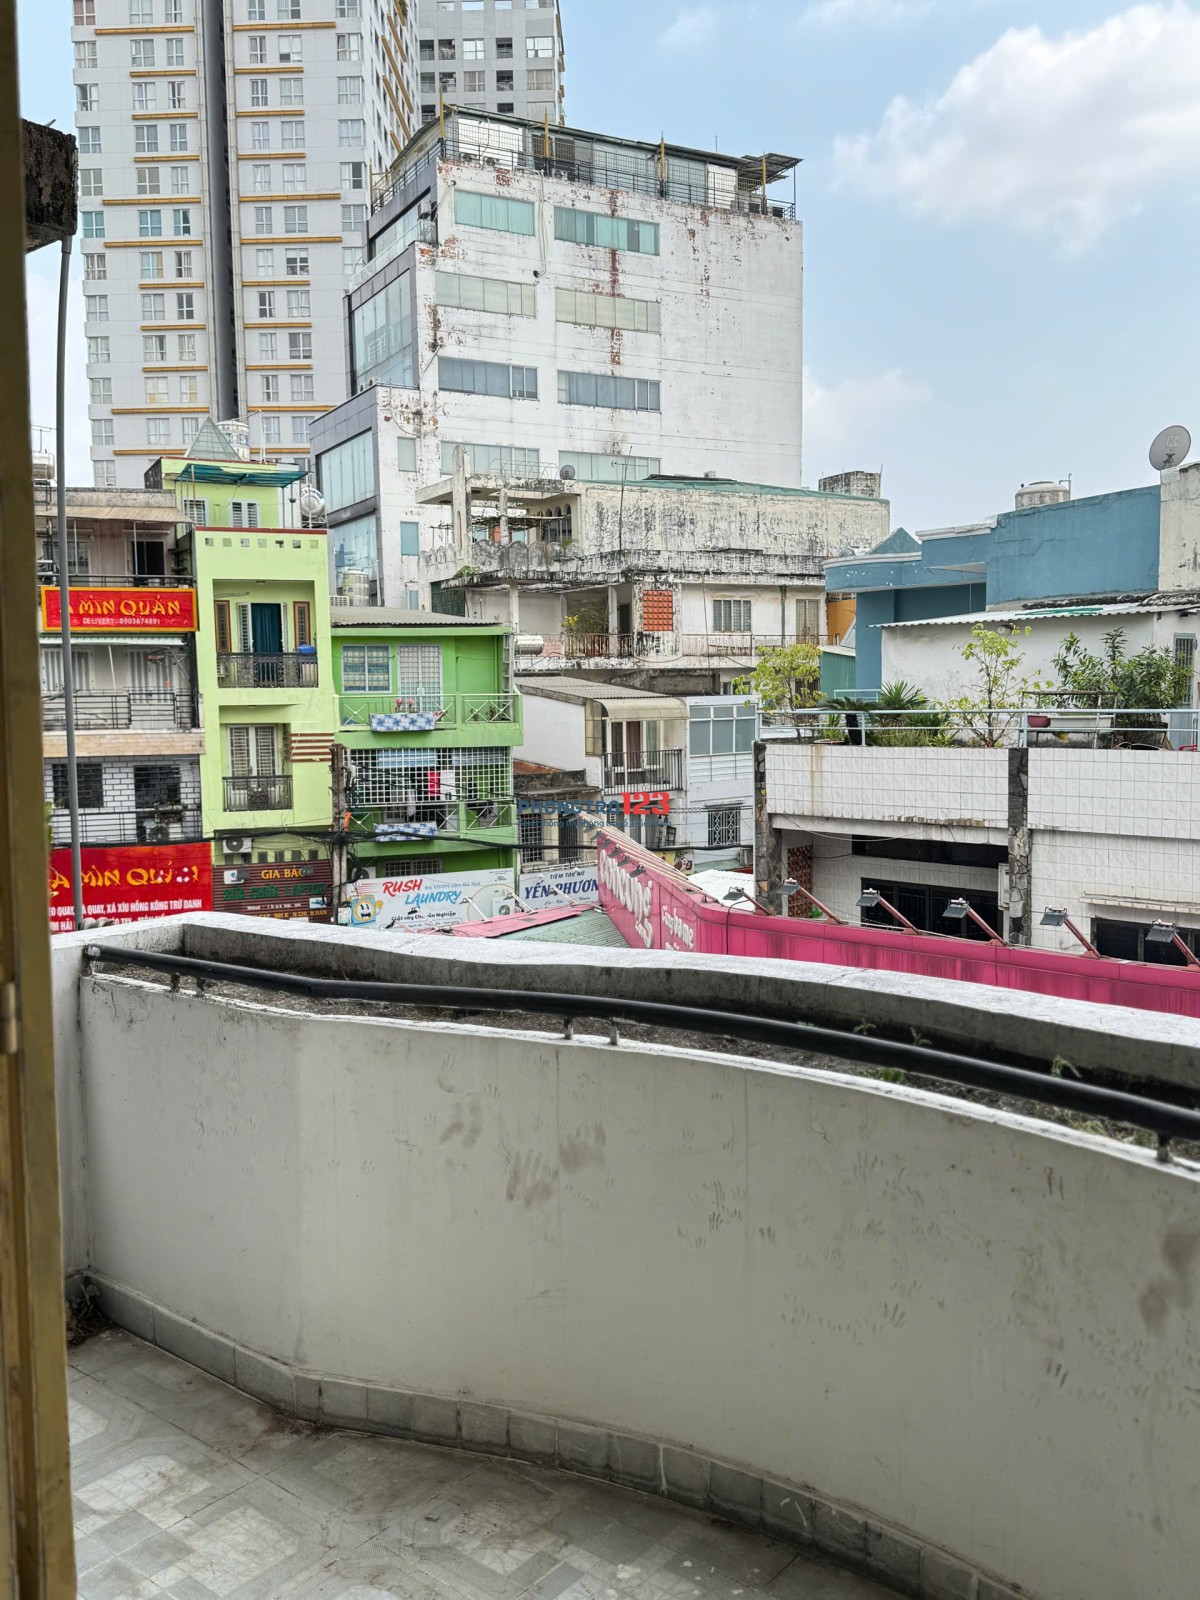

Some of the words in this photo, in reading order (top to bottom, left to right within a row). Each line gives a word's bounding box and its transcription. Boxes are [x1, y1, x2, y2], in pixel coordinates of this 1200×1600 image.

[261, 869, 280, 879] GIA
[382, 879, 423, 896] RUSH
[525, 880, 551, 899] YẾN
[183, 898, 203, 909] DANH
[405, 890, 461, 906] LAUNDRY
